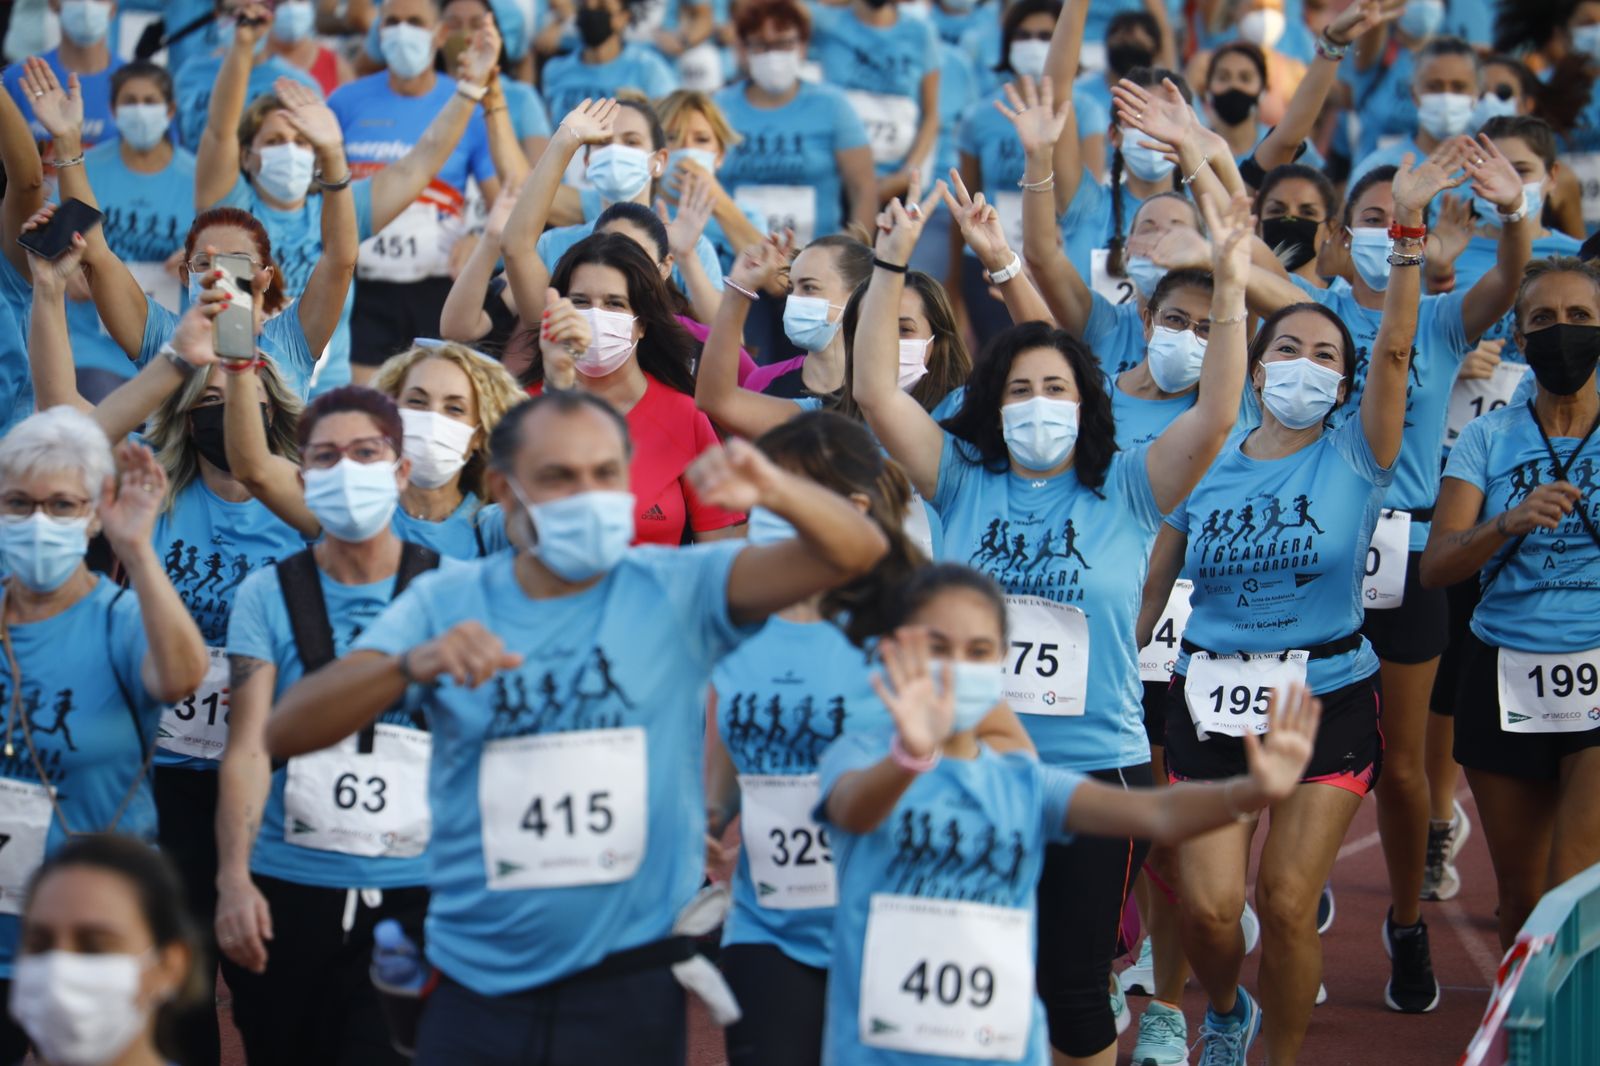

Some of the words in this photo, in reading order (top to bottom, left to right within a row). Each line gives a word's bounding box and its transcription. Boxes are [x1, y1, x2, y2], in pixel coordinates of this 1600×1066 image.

[372, 237, 418, 258] 451
[1198, 562, 1244, 580] MUJER
[1155, 618, 1177, 648] 4
[1002, 641, 1059, 677] 75
[1528, 662, 1599, 698] 199
[174, 691, 230, 726] 31
[1209, 685, 1271, 715] 195
[334, 772, 387, 813] 63
[519, 791, 614, 838] 415
[901, 960, 995, 1009] 409
